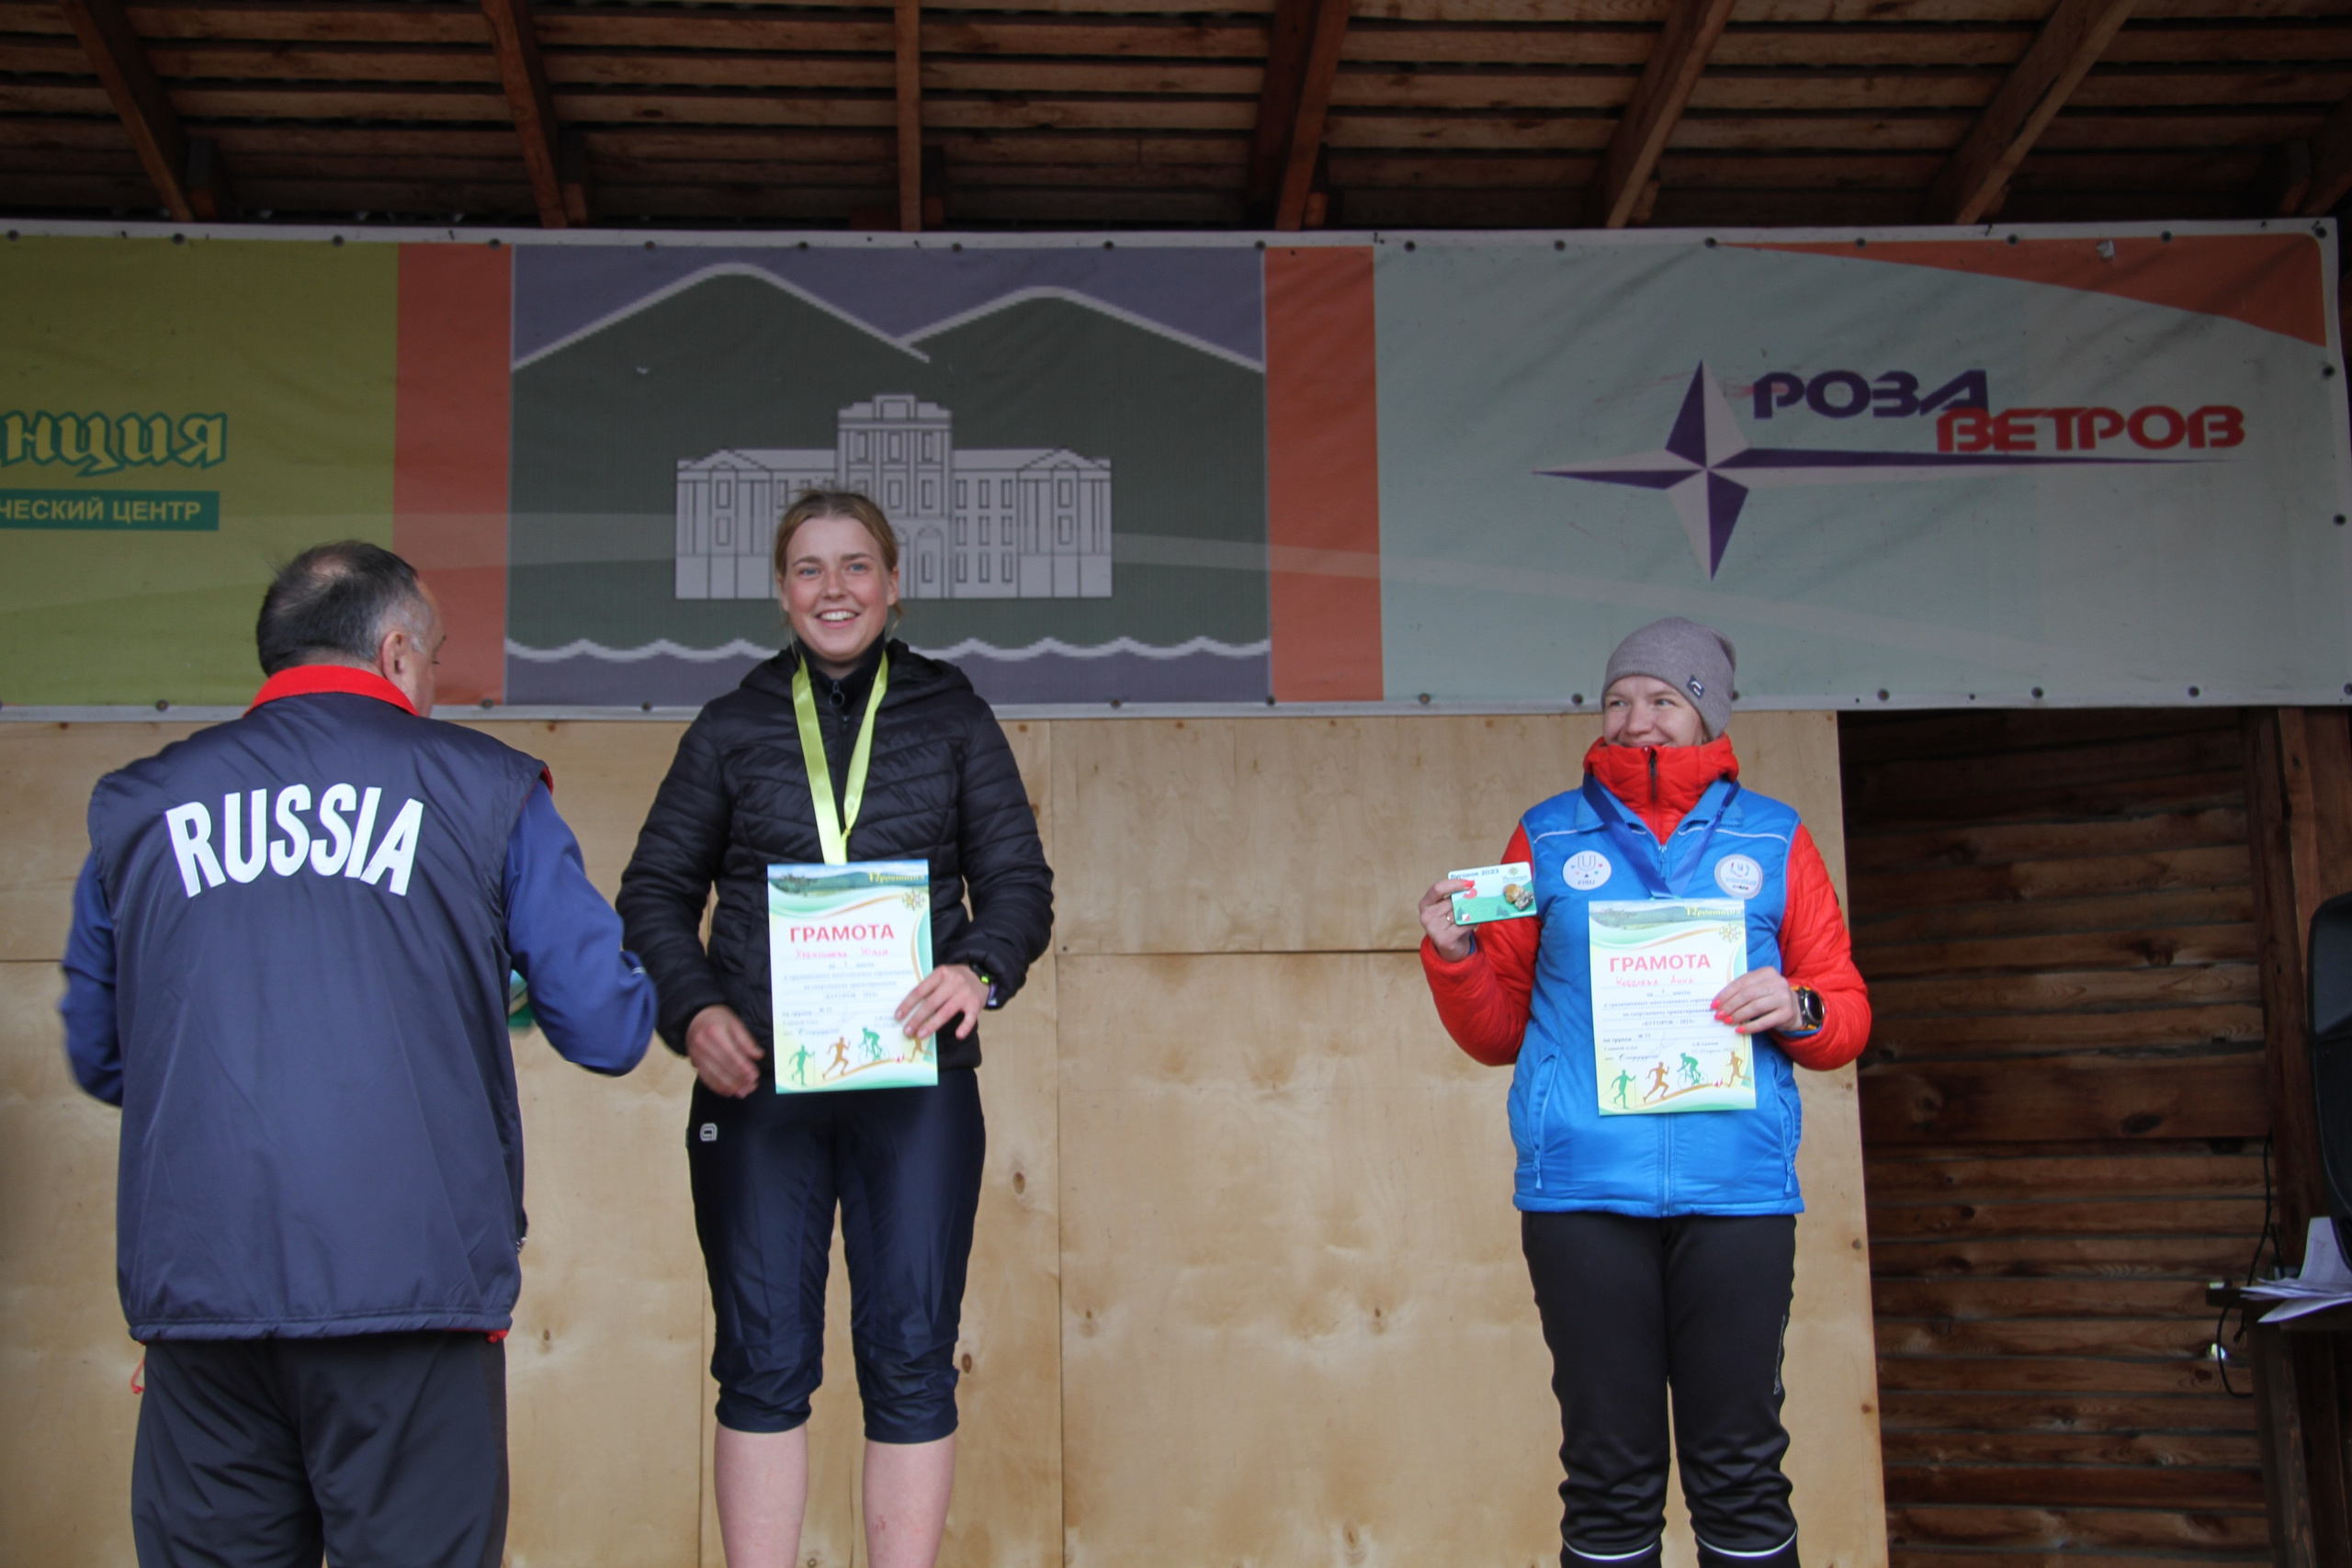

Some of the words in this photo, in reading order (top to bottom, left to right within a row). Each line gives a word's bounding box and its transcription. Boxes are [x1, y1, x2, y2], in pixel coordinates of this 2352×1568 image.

[1754, 369, 1990, 419] РОЗА
[1936, 404, 2245, 453] ВЕТРОВ
[112, 500, 201, 524] ЦЕНТР
[164, 783, 424, 898] RUSSIA
[790, 923, 895, 943] ГРАМОТА
[1610, 953, 1712, 973] ГРАМОТА
